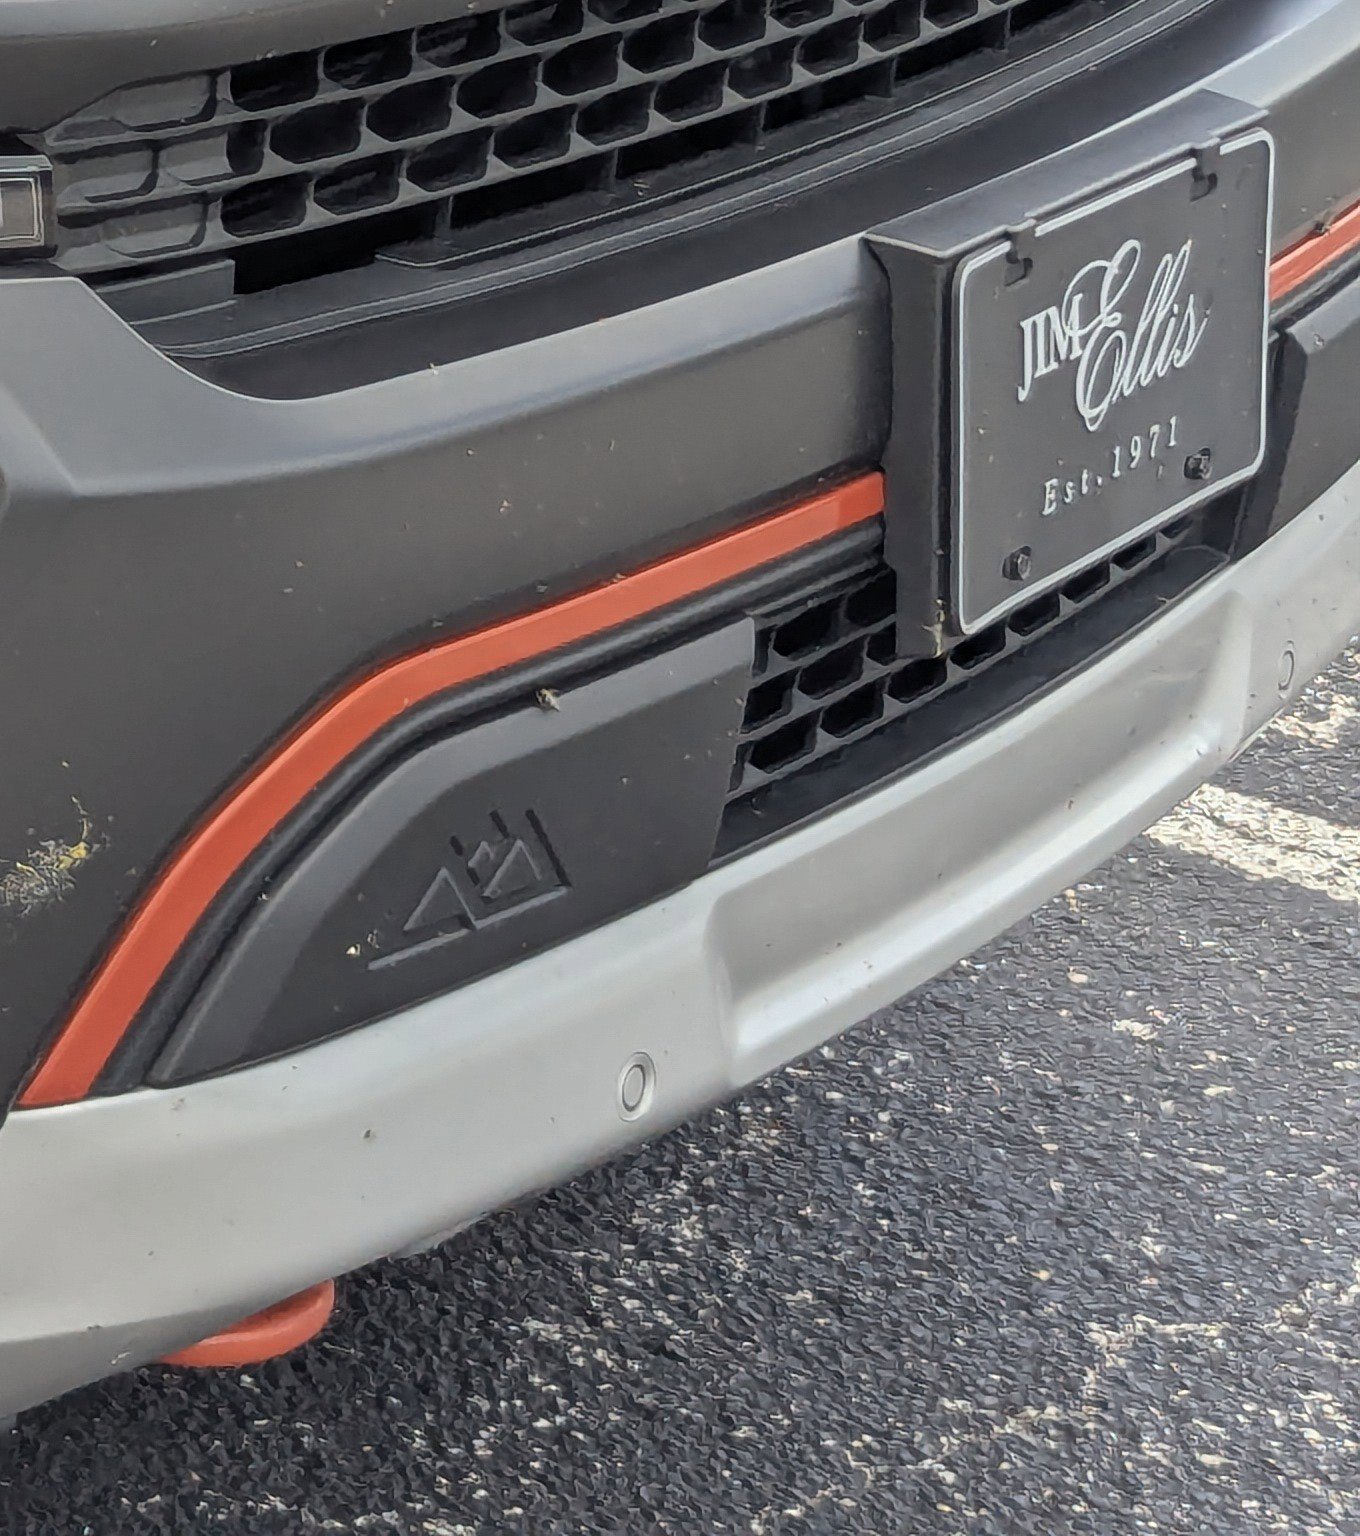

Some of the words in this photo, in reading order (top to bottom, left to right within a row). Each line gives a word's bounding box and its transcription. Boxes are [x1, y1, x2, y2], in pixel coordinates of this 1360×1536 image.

[1017, 294, 1083, 403] JIM
[1061, 238, 1212, 433] Ellis
[1041, 468, 1103, 516] Est.
[1110, 415, 1179, 478] 1971
